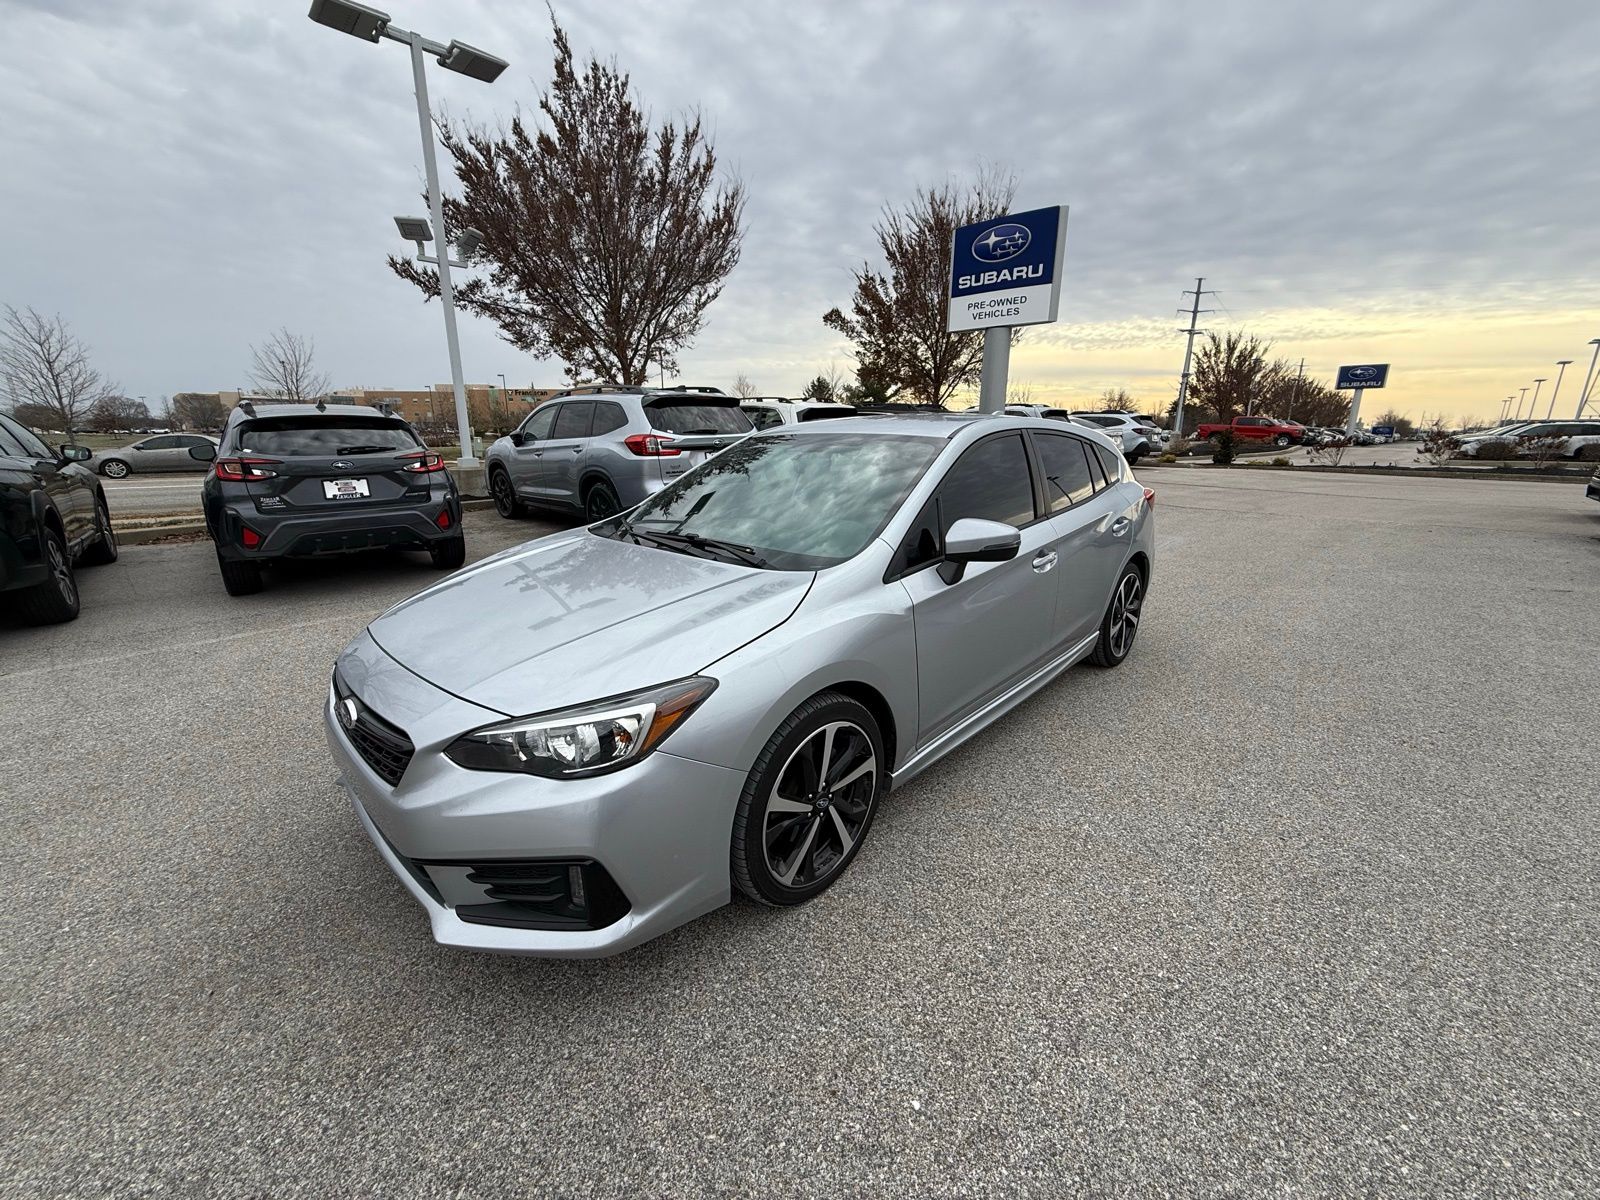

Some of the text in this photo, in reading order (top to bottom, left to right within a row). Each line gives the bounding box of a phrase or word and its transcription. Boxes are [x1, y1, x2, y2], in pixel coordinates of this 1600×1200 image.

[958, 263, 1044, 289] SUBARU
[967, 295, 1027, 311] PRE-OWNED
[972, 307, 1020, 320] VEHICLES
